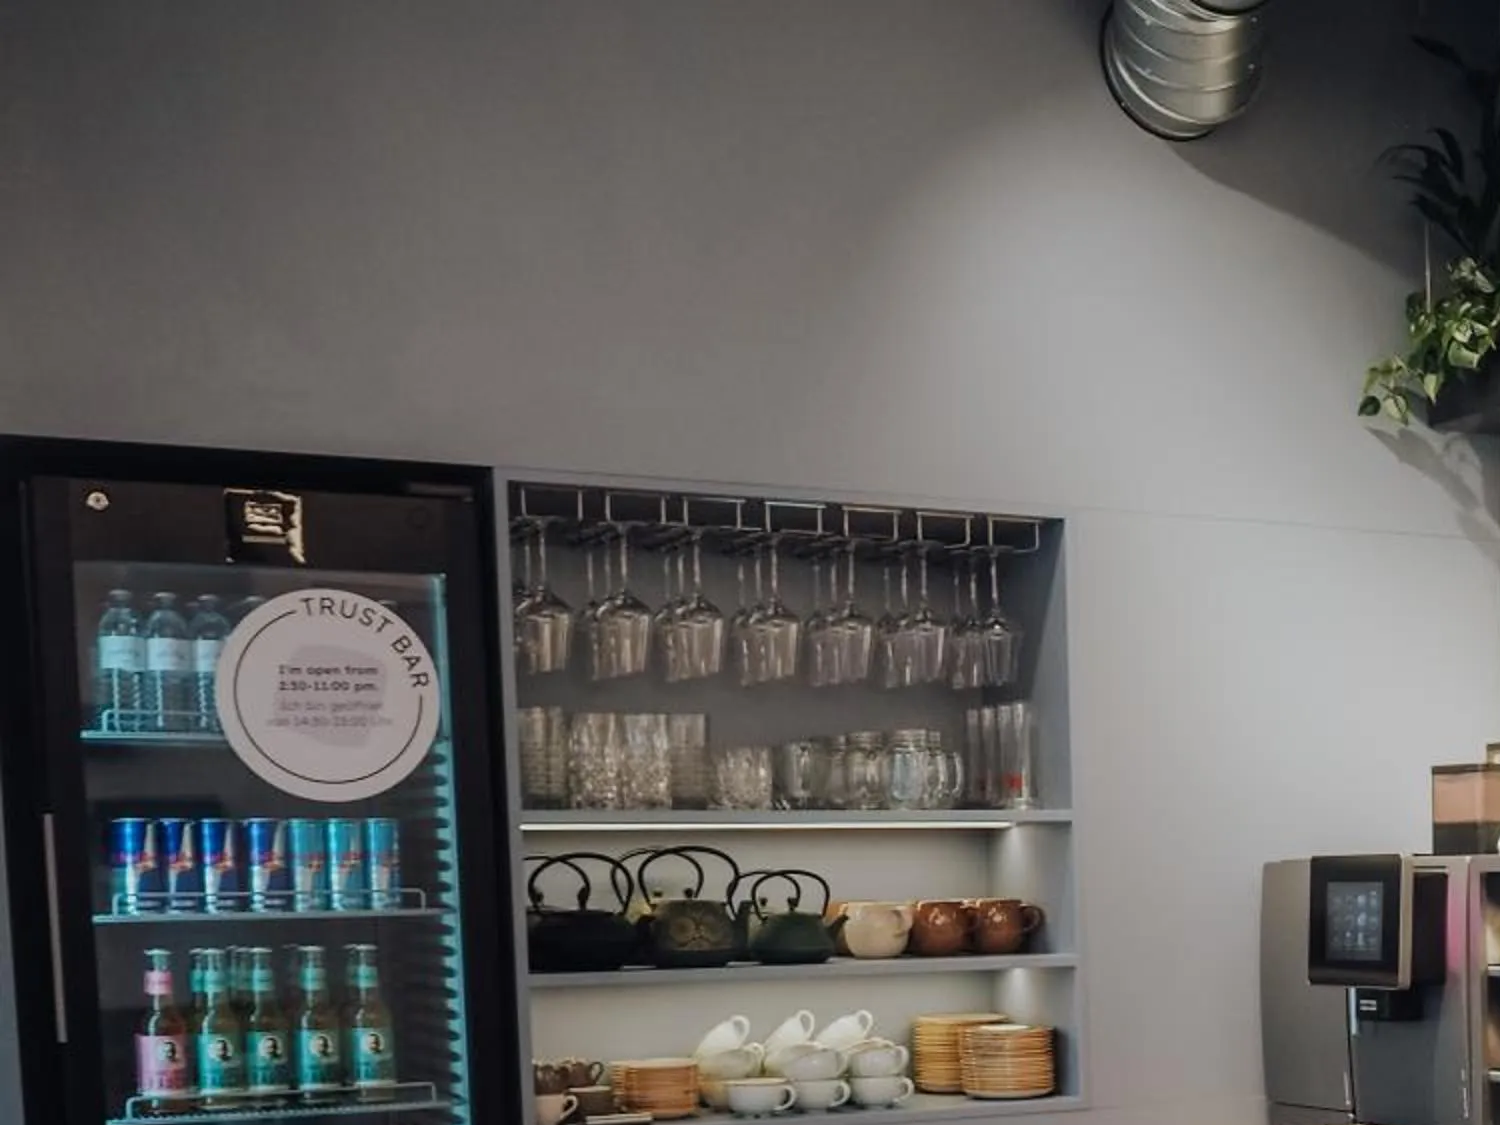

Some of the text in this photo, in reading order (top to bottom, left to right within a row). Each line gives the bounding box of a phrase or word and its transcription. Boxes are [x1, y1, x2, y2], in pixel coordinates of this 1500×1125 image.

[300, 597, 430, 689] TRUST BAR
[306, 666, 341, 677] open
[345, 665, 378, 675] from
